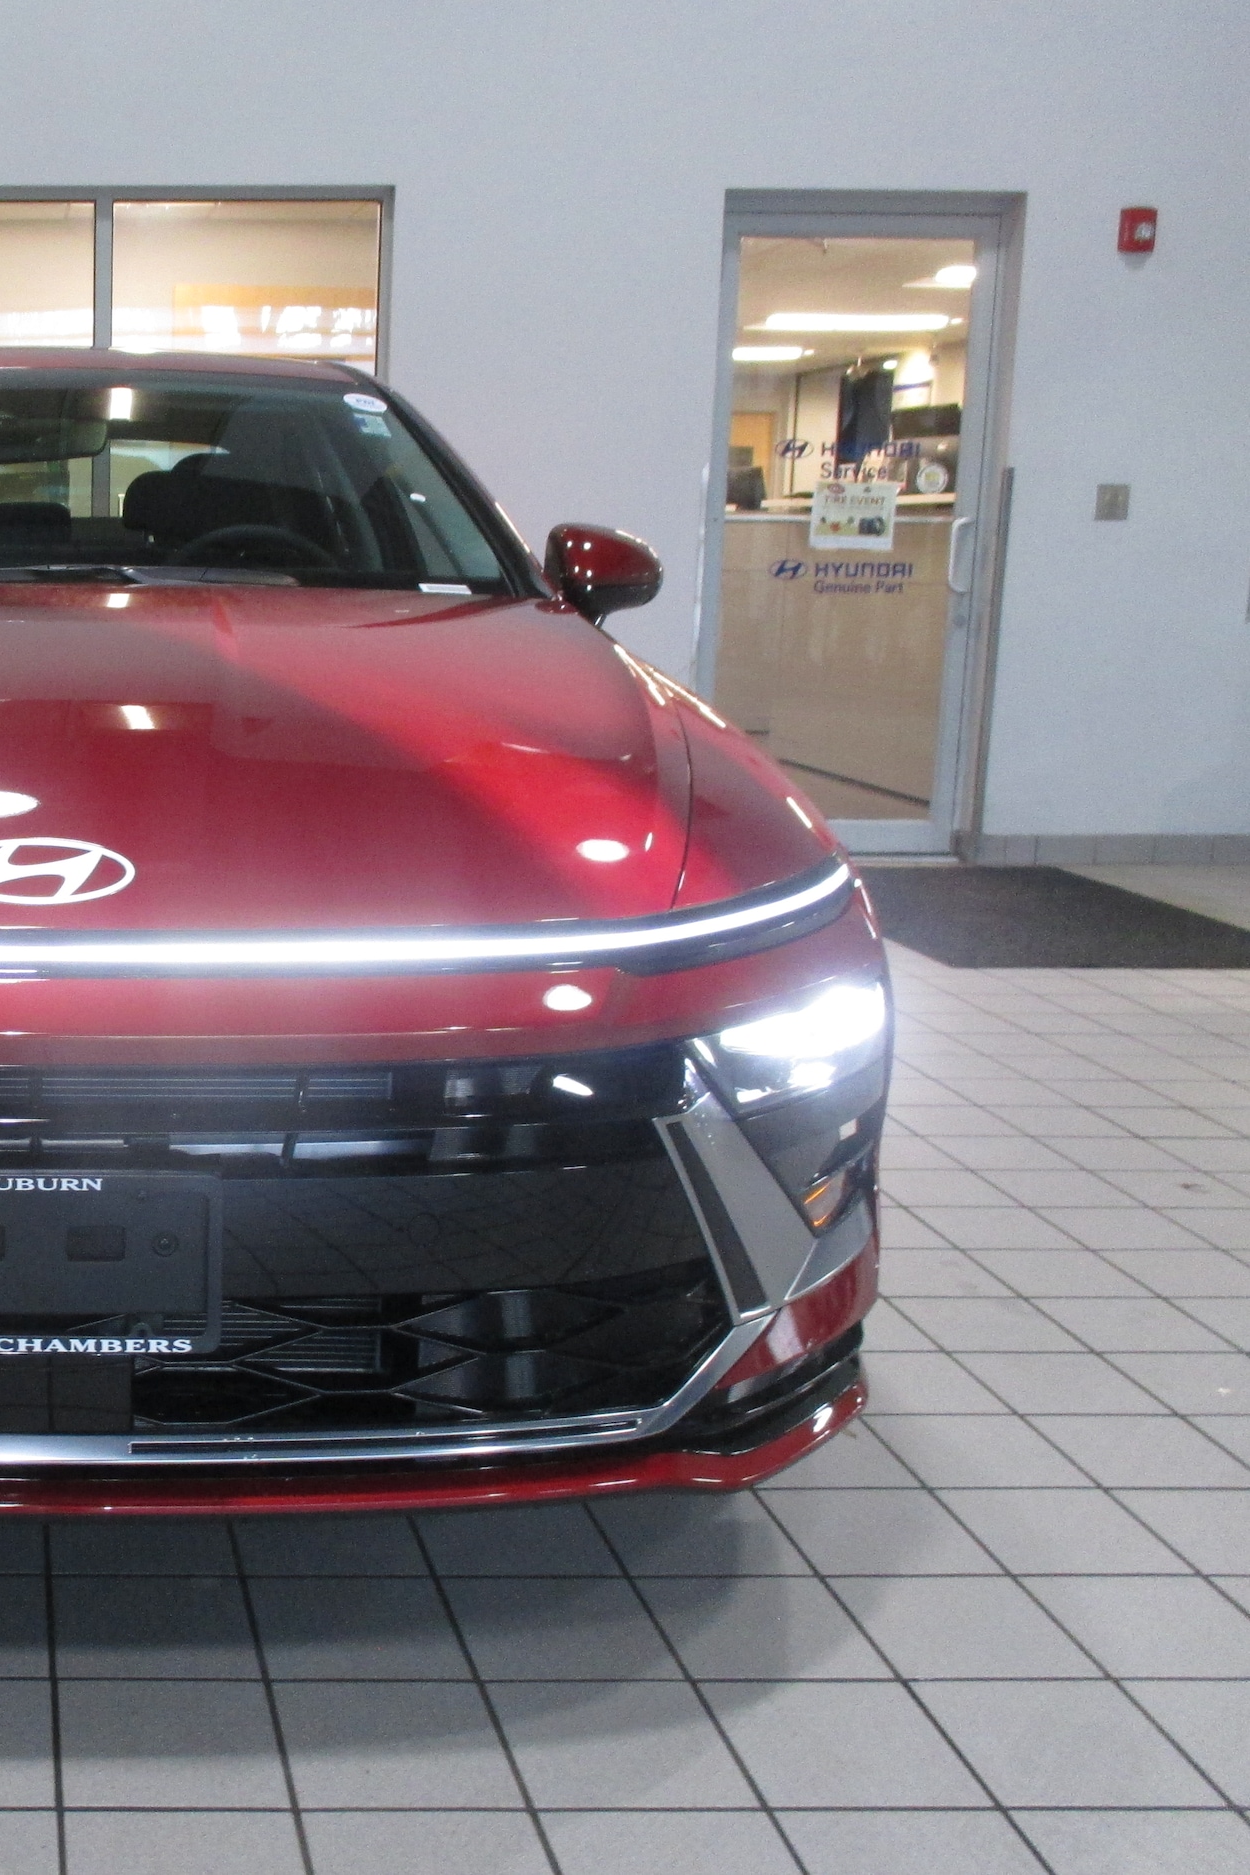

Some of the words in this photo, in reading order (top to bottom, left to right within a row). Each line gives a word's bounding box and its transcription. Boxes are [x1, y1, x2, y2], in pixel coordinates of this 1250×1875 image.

[821, 441, 921, 458] HNDAI
[821, 461, 889, 479] Service
[850, 495, 886, 506] EVENT
[815, 561, 913, 577] HYUNDAI
[814, 580, 871, 594] Genuine
[875, 581, 904, 594] Part
